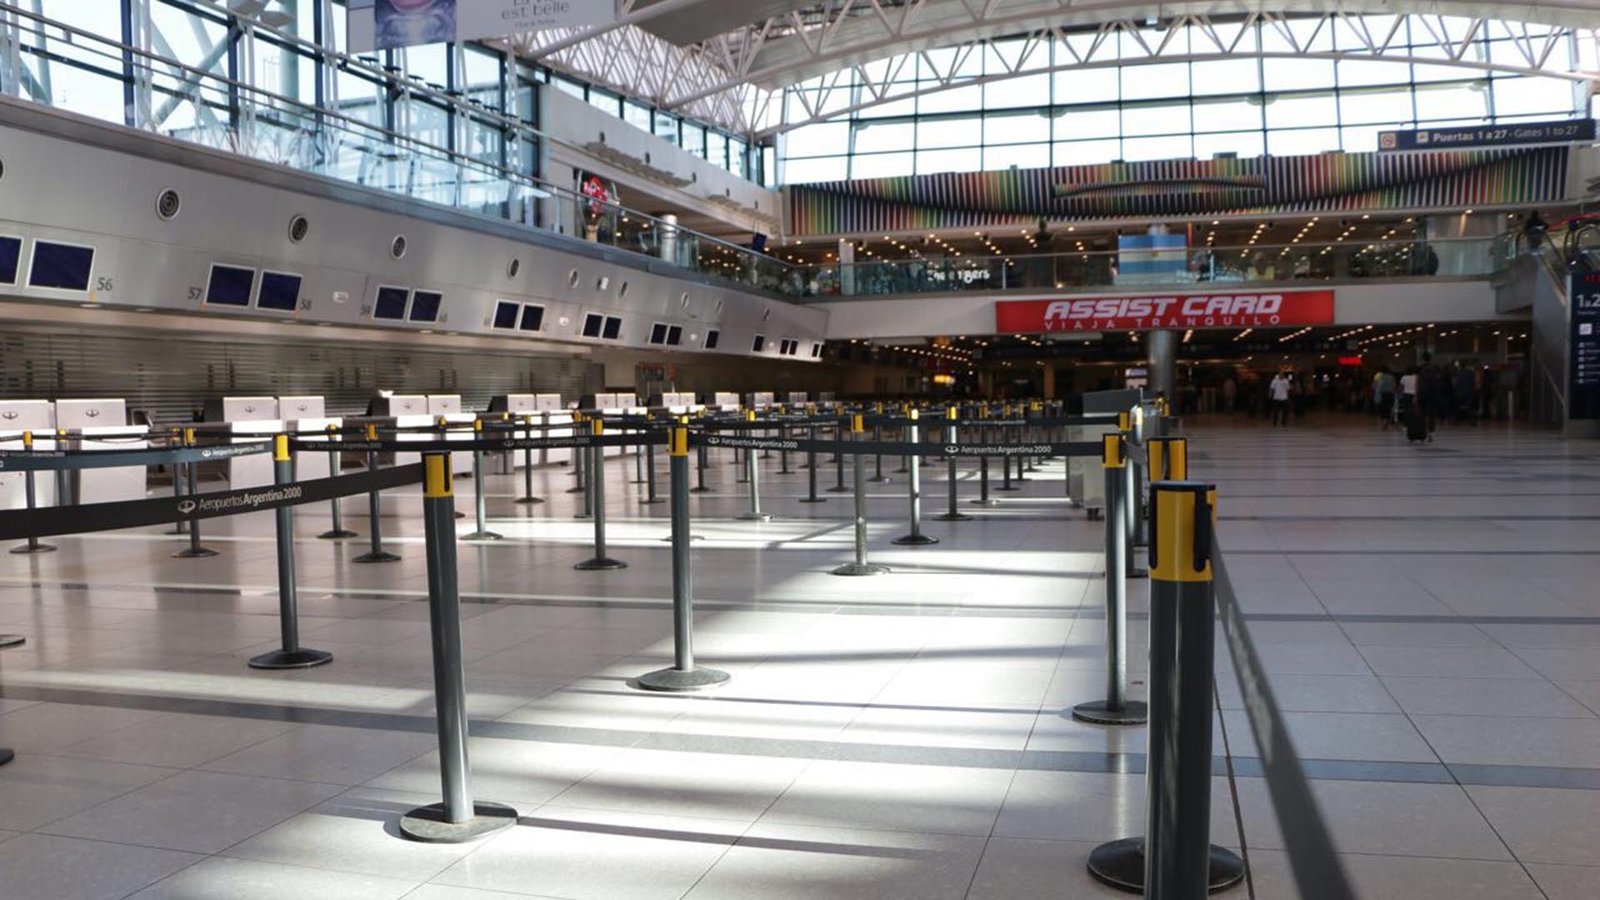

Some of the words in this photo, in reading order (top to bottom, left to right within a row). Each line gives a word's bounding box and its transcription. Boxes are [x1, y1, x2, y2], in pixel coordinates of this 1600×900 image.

[501, 7, 528, 19] est
[533, 2, 570, 16] belle
[1433, 132, 1475, 142] Puertas
[1494, 129, 1507, 139] 27
[1514, 128, 1543, 138] Gates
[1553, 127, 1565, 135] to
[1566, 125, 1579, 135] 27
[97, 277, 113, 291] 56
[188, 287, 202, 299] 57
[1045, 298, 1176, 319] ASSIST
[1181, 295, 1282, 316] CARD
[1045, 319, 1115, 330] VIAJA
[1137, 315, 1280, 327] TRANQUILO
[751, 439, 782, 448] Argentina
[997, 445, 1033, 455] Argentina
[199, 496, 243, 510] Aeropuertos
[243, 489, 283, 506] Argentina
[283, 486, 302, 498] 2000
